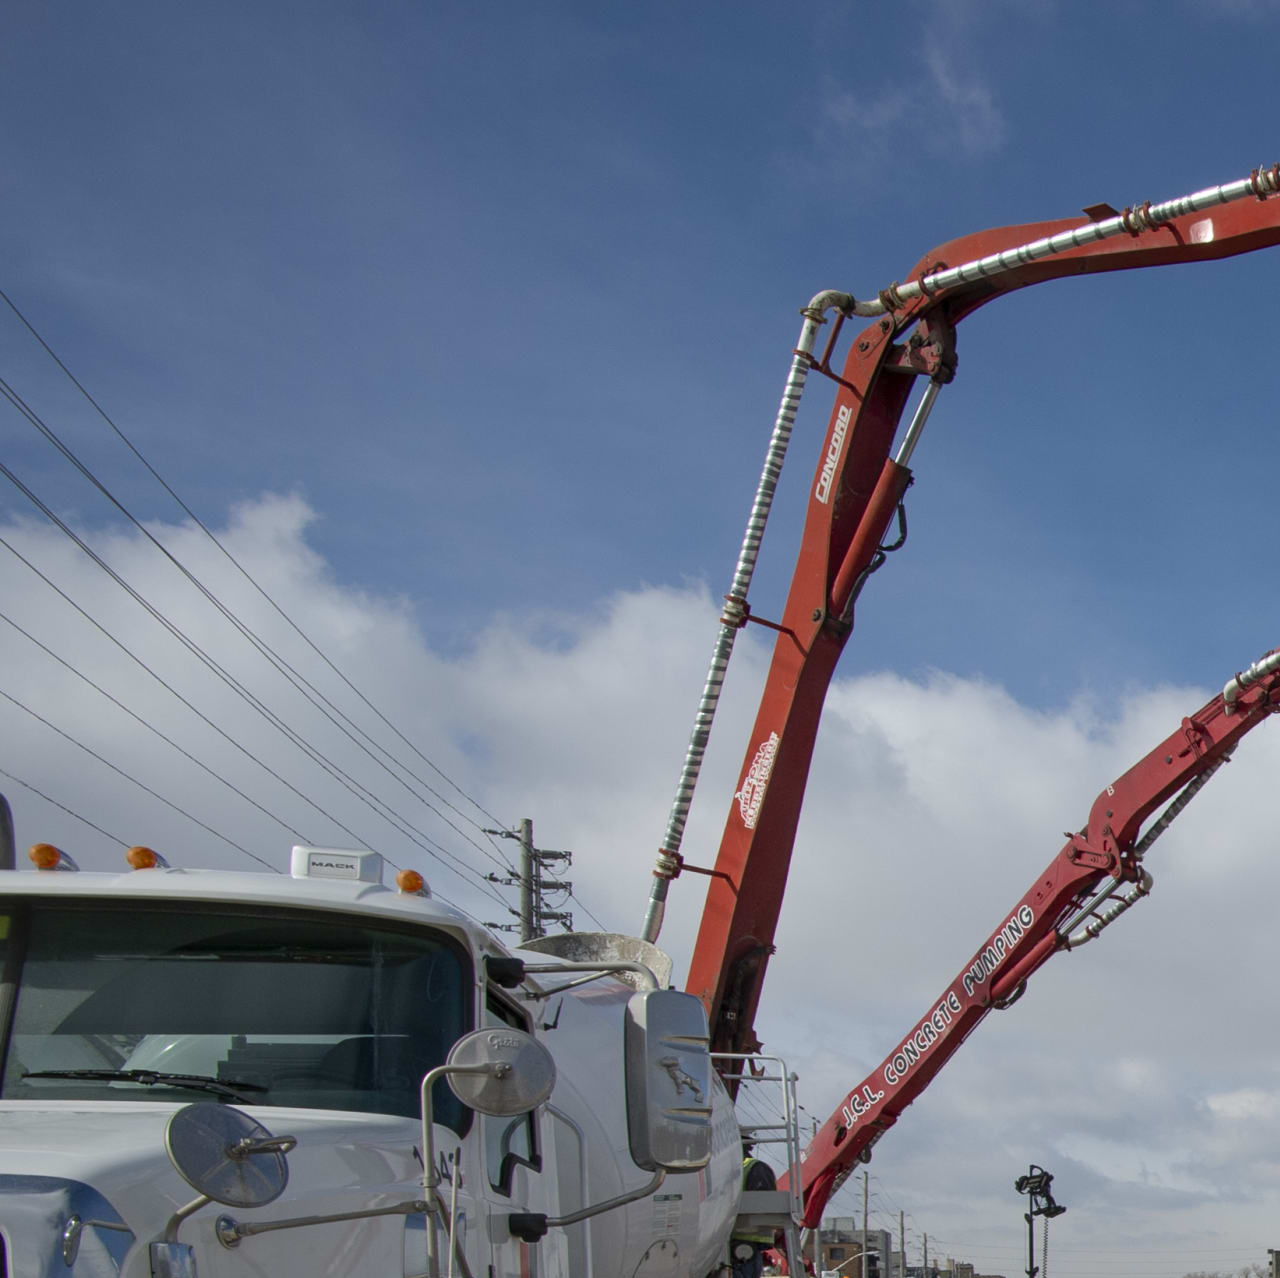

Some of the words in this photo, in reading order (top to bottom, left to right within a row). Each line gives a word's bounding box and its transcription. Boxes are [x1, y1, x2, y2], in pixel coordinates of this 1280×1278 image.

[815, 404, 850, 504] CONCORD
[311, 861, 355, 870] MACK
[842, 1085, 884, 1129] J.C.L.
[884, 992, 961, 1086] CONCRETE
[962, 904, 1034, 997] PUMPING
